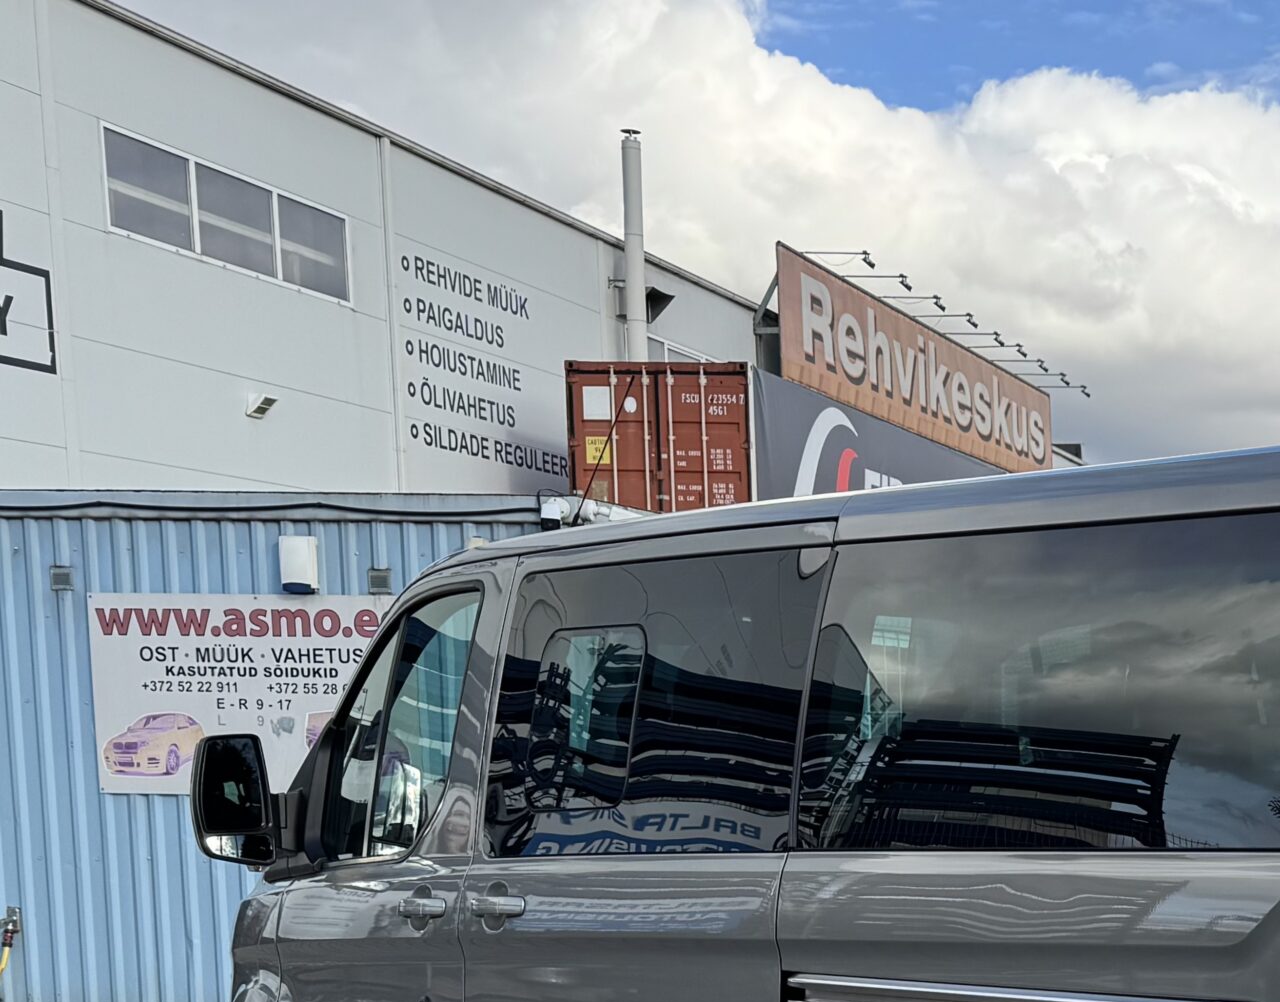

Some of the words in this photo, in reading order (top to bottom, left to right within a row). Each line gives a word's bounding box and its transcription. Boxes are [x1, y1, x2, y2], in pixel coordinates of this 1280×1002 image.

[414, 256, 483, 303] REHVIDE
[487, 283, 530, 320] MÜÜK
[416, 298, 505, 348] PAIGALDUS
[418, 339, 522, 392] HOIUSTAMINE
[800, 272, 1046, 466] Rehvikeskus
[420, 377, 516, 428] ÕLIVAHETUS
[681, 393, 700, 403] FSCU
[423, 423, 490, 460] SILDADE
[494, 440, 569, 478] REGULEER
[95, 607, 388, 638] www.asmo.e
[139, 646, 180, 663] OST
[195, 644, 254, 664] MÜÜK
[271, 647, 364, 664] VAHETUS
[141, 680, 174, 692] +372
[177, 680, 193, 693] 52
[197, 681, 213, 693] 22
[216, 681, 238, 693] 911
[165, 665, 258, 678] KASUTATUD
[263, 664, 339, 678] SÕIDUKID
[216, 698, 225, 709] E
[238, 698, 248, 710] R
[256, 699, 264, 710] 9
[277, 699, 292, 710] 17
[267, 682, 299, 694] +372
[303, 683, 319, 695] 55
[322, 683, 338, 695] 28
